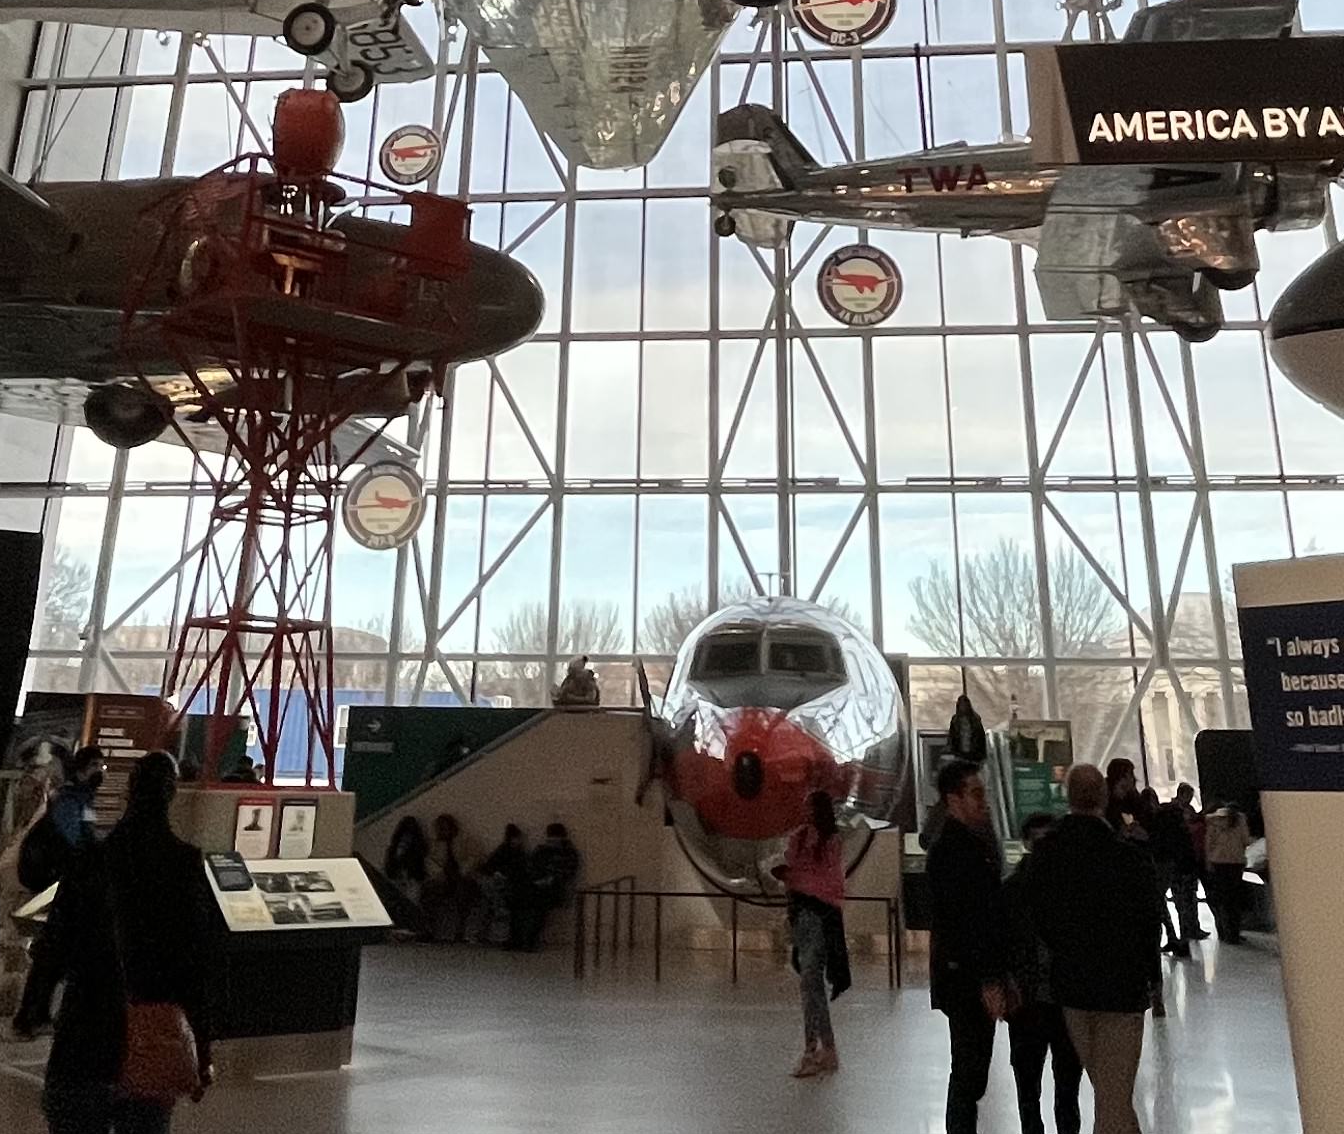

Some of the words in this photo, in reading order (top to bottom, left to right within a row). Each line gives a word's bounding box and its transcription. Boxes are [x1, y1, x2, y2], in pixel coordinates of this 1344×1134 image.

[830, 31, 860, 44] DC-3
[1088, 108, 1258, 143] AMERICA
[1262, 107, 1309, 138] BY
[896, 164, 988, 193] TWA
[1286, 636, 1340, 658] always
[1286, 710, 1304, 727] so
